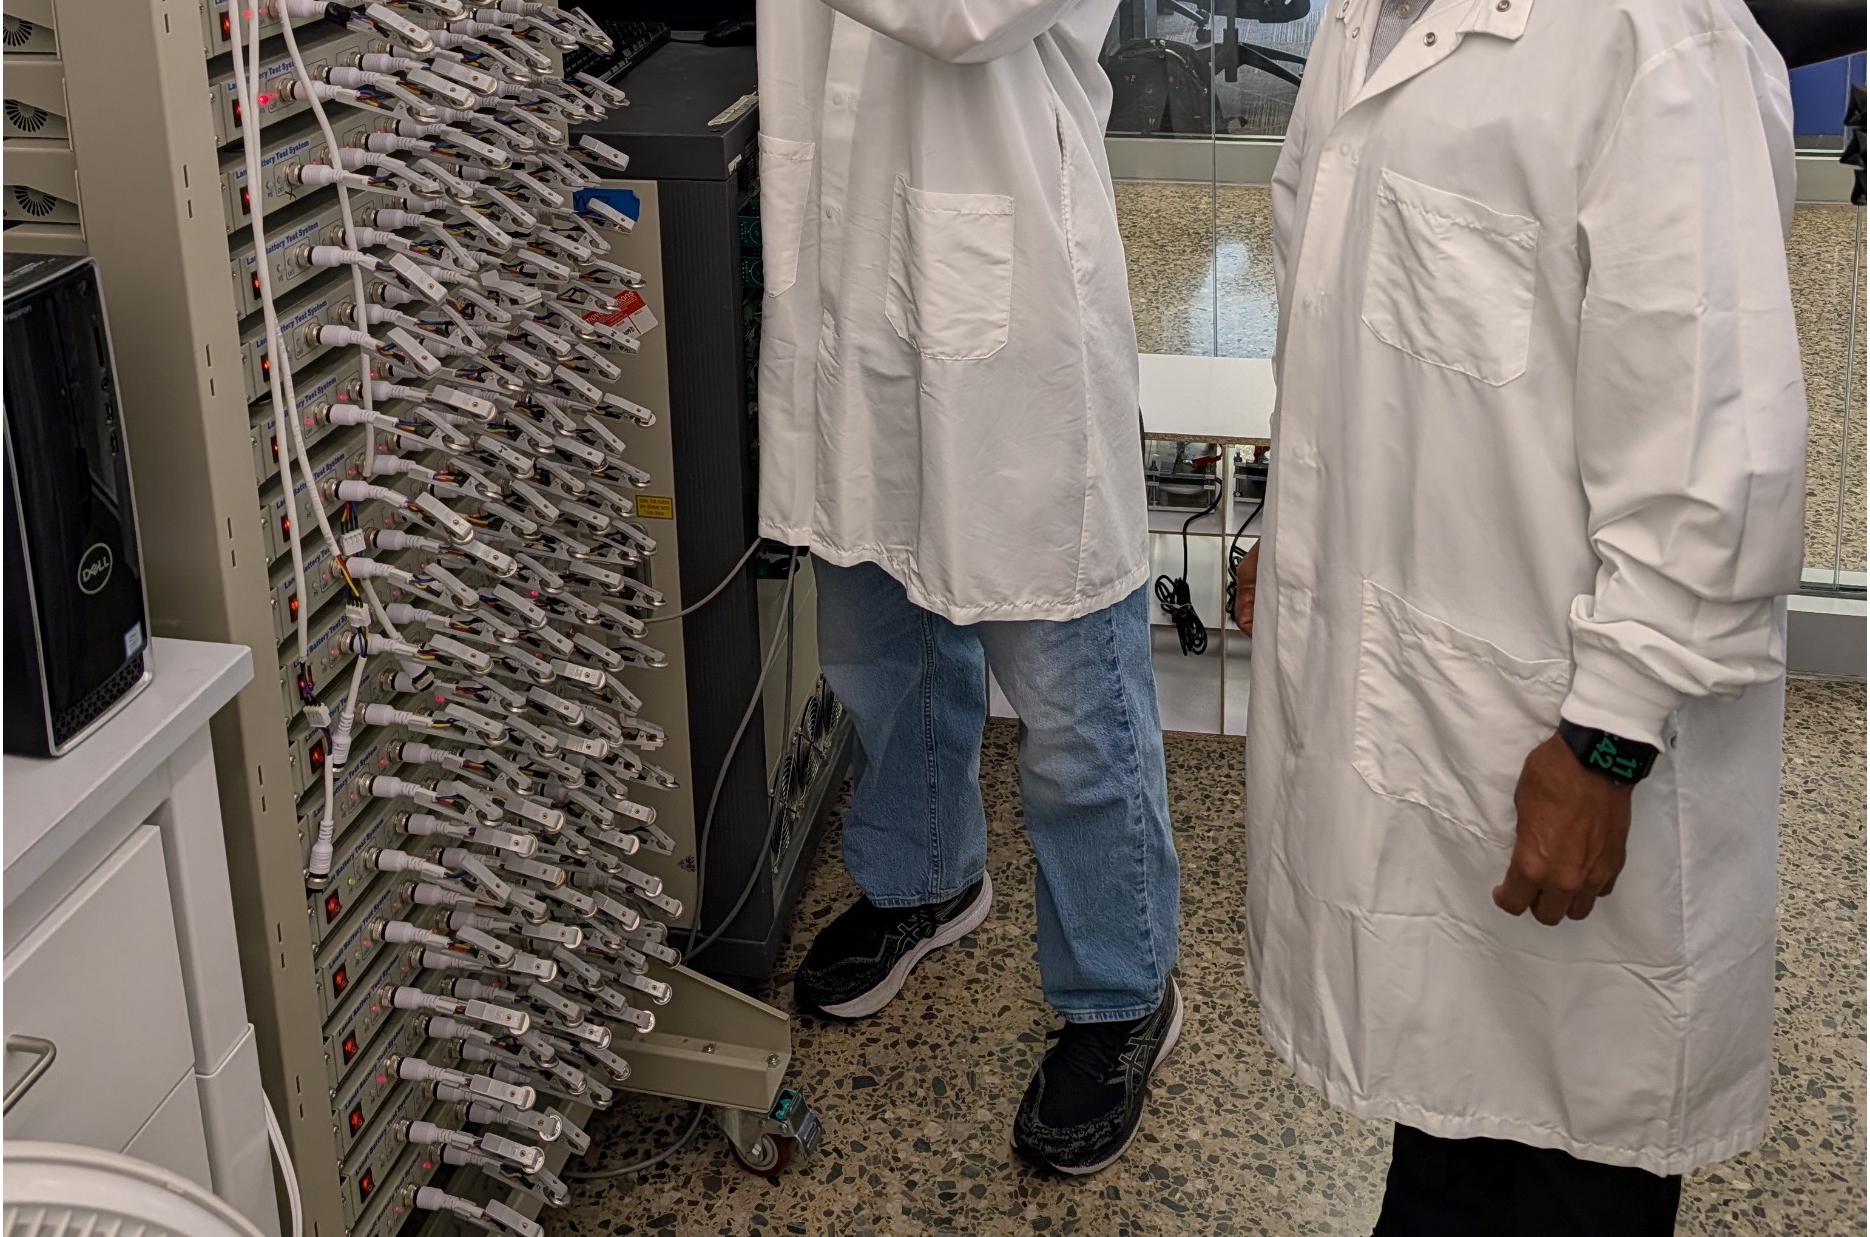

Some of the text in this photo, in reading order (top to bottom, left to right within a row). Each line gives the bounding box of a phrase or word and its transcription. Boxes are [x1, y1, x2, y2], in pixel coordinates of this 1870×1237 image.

[268, 65, 281, 76] Test
[275, 148, 289, 160] Test
[288, 140, 310, 155] System
[285, 233, 298, 243] Test
[298, 222, 319, 237] System
[294, 312, 308, 324] Test
[307, 300, 328, 316] System
[304, 389, 318, 403] Test
[317, 377, 337, 394] System
[313, 467, 326, 480] Test
[325, 453, 345, 471] System
[82, 556, 110, 582] DELL
[303, 555, 321, 573] attery
[309, 622, 341, 653] Battery Test
[348, 765, 360, 778] Test
[359, 746, 378, 766] System
[1589, 736, 1618, 769] 42
[1612, 756, 1637, 779] 11
